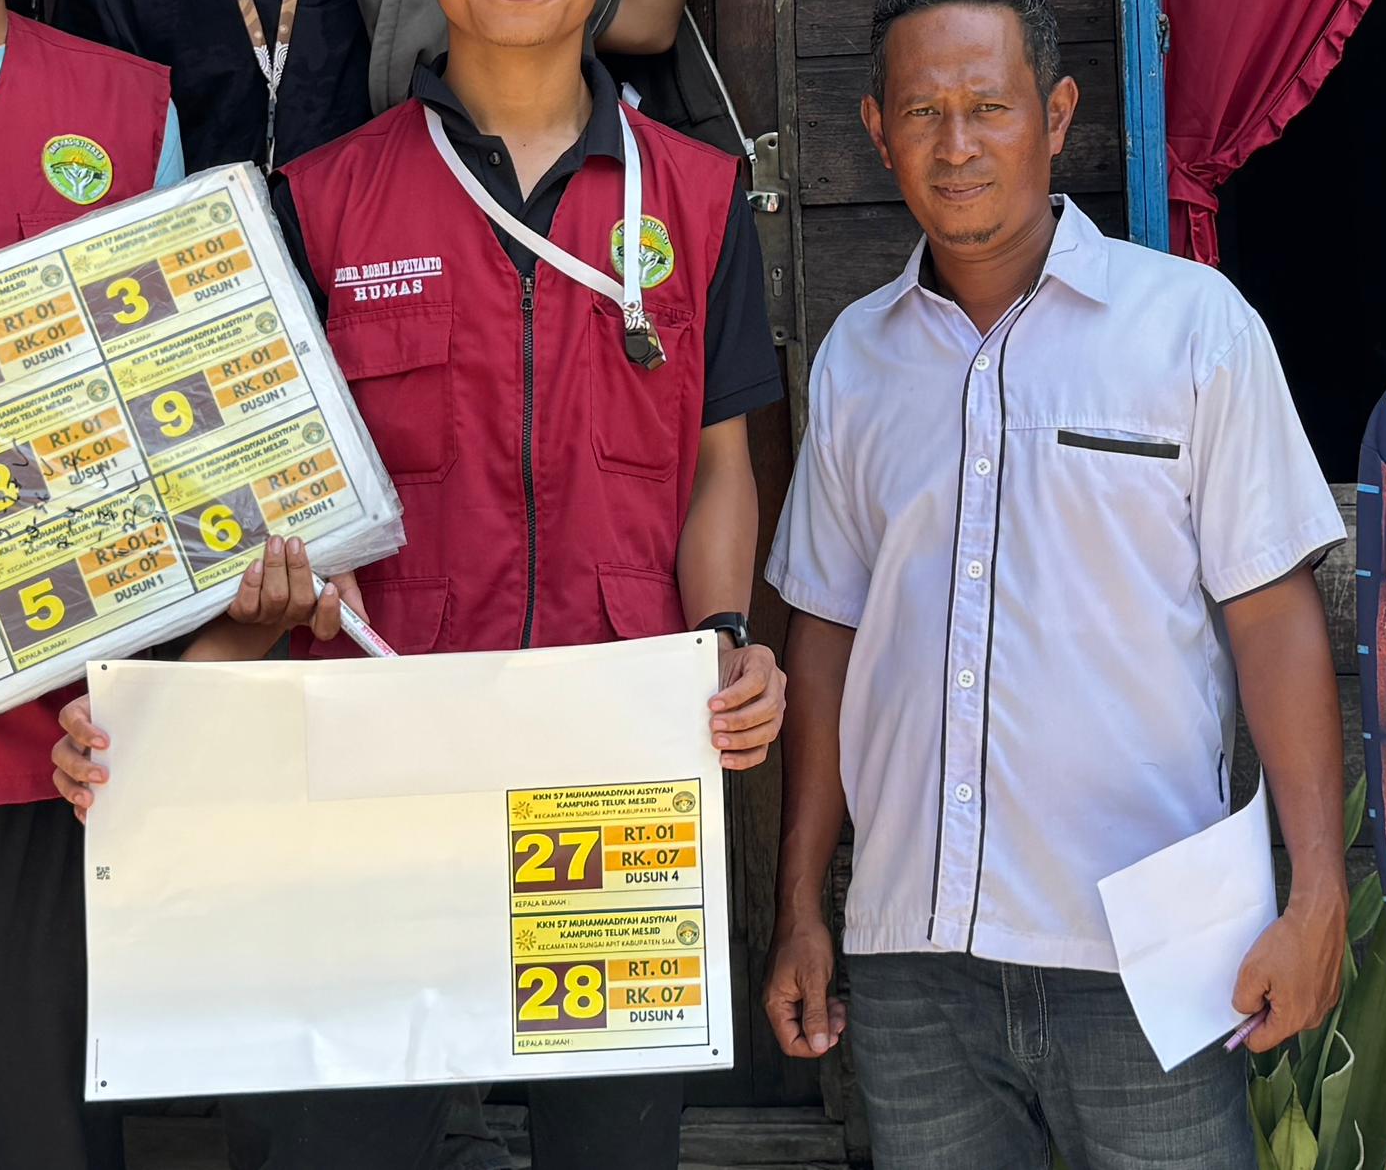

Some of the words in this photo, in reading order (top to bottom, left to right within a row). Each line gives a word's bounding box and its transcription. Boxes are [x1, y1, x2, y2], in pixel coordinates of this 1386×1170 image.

[174, 244, 203, 266] RT.
[203, 235, 225, 254] 01
[185, 265, 214, 287] RK.
[215, 257, 235, 275] 01
[392, 257, 442, 275] APRIYANTO
[108, 279, 149, 324] 3
[194, 278, 233, 301] DUSUN
[233, 276, 240, 286] 1
[354, 280, 422, 301] HUMAS
[2, 309, 32, 332] RT.
[33, 300, 56, 319] 01
[13, 331, 44, 353] RK.
[45, 322, 66, 340] 01
[22, 345, 64, 369] DUSUN
[64, 342, 72, 352] 1
[220, 355, 249, 377] RT.
[249, 346, 271, 365] 01
[231, 376, 260, 398] RK.
[261, 367, 281, 386] 01
[239, 389, 279, 413] DUSUN
[279, 386, 286, 396] 1
[155, 393, 193, 437] 9
[48, 425, 79, 448] RT.
[79, 415, 102, 435] 01
[59, 446, 90, 469] RK.
[91, 437, 112, 456] 01
[110, 456, 117, 467] 1
[267, 467, 296, 490] RT.
[297, 457, 319, 477] 01
[278, 487, 308, 510] RK.
[308, 478, 329, 497] 01
[286, 500, 327, 526] DUSUN
[326, 497, 334, 508] 1
[126, 531, 148, 551] 01
[202, 506, 242, 551] 6
[105, 562, 137, 586] RK.
[137, 553, 158, 572] 01
[114, 576, 156, 602] DUSUN
[156, 573, 164, 584] 1
[21, 580, 65, 631] 5
[533, 793, 551, 801] KKN
[553, 792, 563, 800] 57
[565, 788, 634, 799] MUHAMMADIYAH
[556, 800, 598, 809] KAMPUNG
[601, 798, 625, 806] TELUK
[627, 796, 656, 805] MESJID
[624, 826, 649, 840] RT.
[656, 824, 674, 839] 01
[515, 830, 600, 883] 27
[622, 851, 650, 866] RK.
[656, 849, 679, 864] 07
[625, 871, 668, 883] DUSUN
[672, 870, 678, 881] 4
[536, 920, 555, 929] KKN
[557, 920, 567, 928] 57
[569, 916, 638, 927] MUHAMMADIYAH
[560, 929, 602, 939] KAMPUNG
[605, 928, 629, 936] TELUK
[631, 926, 660, 935] MESJID
[628, 960, 654, 976] RT.
[660, 959, 678, 974] 01
[518, 964, 604, 1021] 28
[625, 988, 654, 1004] RK.
[660, 986, 684, 1002] 07
[630, 1009, 672, 1022] DUSUN
[676, 1009, 683, 1020] 4
[518, 1039, 542, 1047] KEPALA
